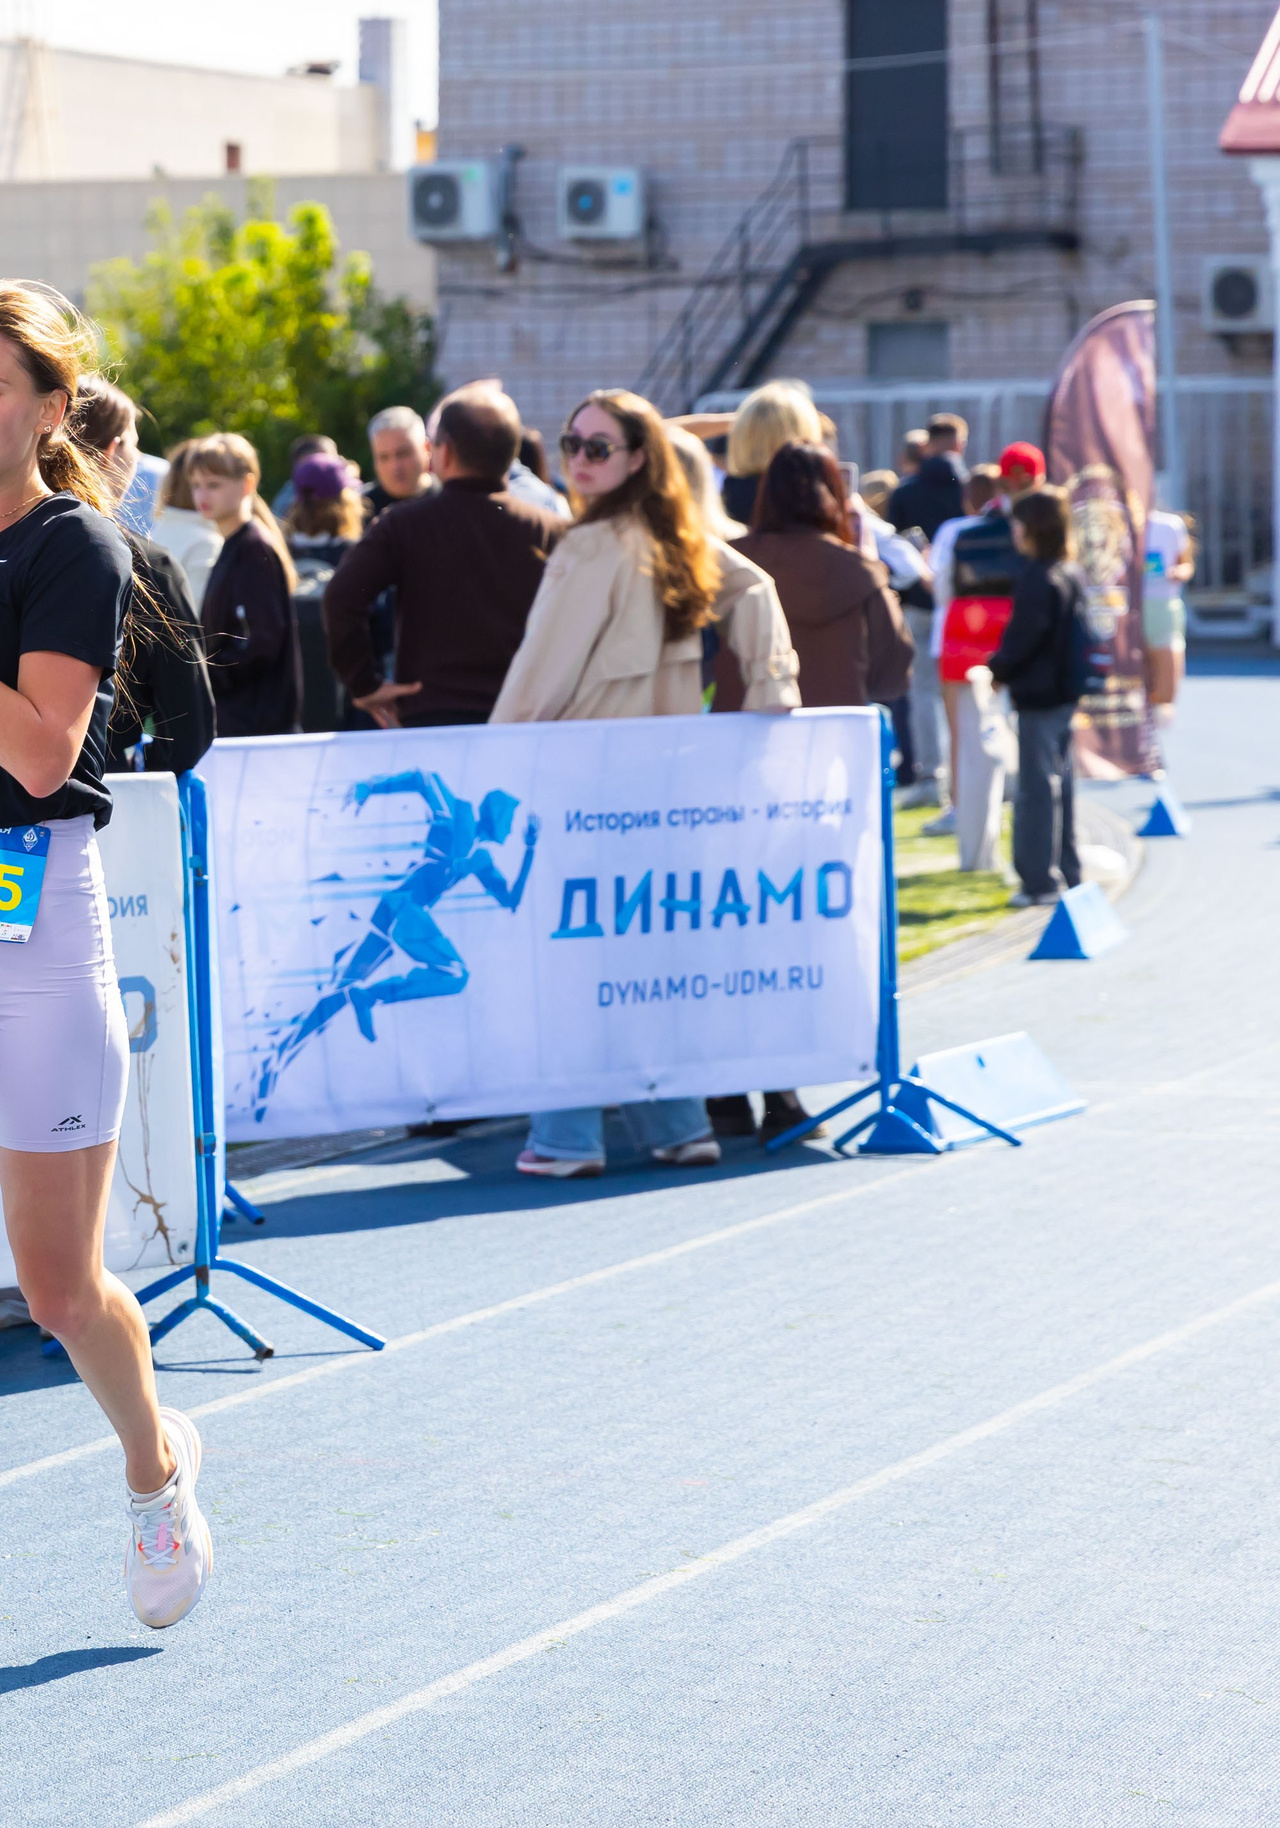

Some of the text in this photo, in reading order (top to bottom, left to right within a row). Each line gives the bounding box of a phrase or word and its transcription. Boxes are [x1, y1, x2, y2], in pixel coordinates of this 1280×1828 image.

[565, 810, 660, 835] История
[666, 802, 746, 829] страны
[766, 798, 853, 824] история
[549, 860, 854, 940] ДИНАМО
[597, 965, 825, 1008] DYNAMO-UDM.RU
[50, 1123, 87, 1133] ATHLEX
